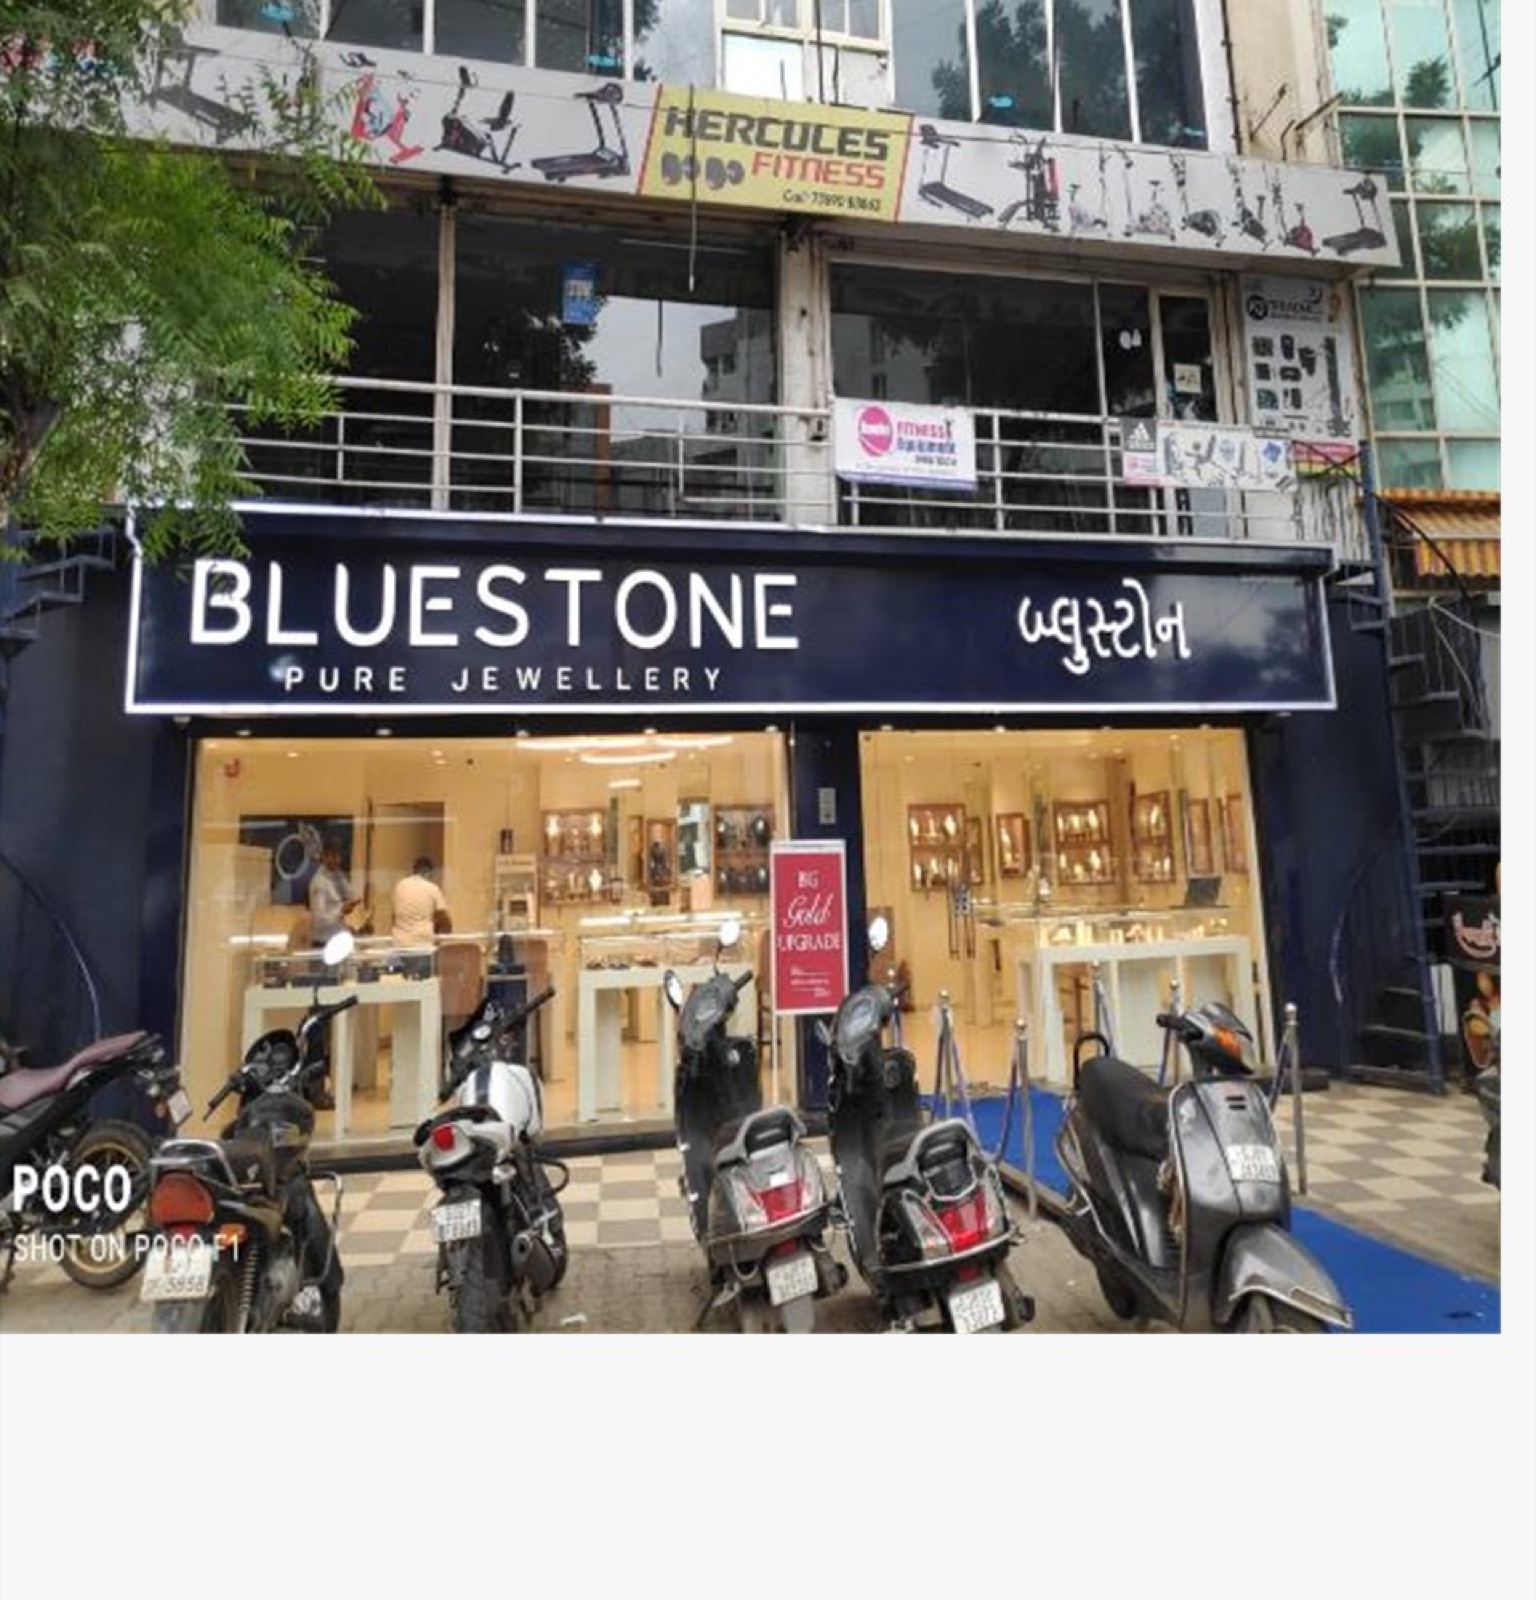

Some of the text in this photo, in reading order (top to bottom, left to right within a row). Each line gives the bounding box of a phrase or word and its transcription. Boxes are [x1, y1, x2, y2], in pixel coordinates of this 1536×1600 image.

[664, 105, 890, 161] HERCULES
[752, 151, 885, 190] FITNESS
[897, 421, 944, 439] FITNESS
[189, 558, 800, 650] BLUESTONE
[1017, 576, 1192, 676] બ્લુસ્ટોન
[284, 666, 724, 692] PURE JEWELLERY
[782, 893, 834, 928] Gold
[777, 931, 842, 952] UPGRADE
